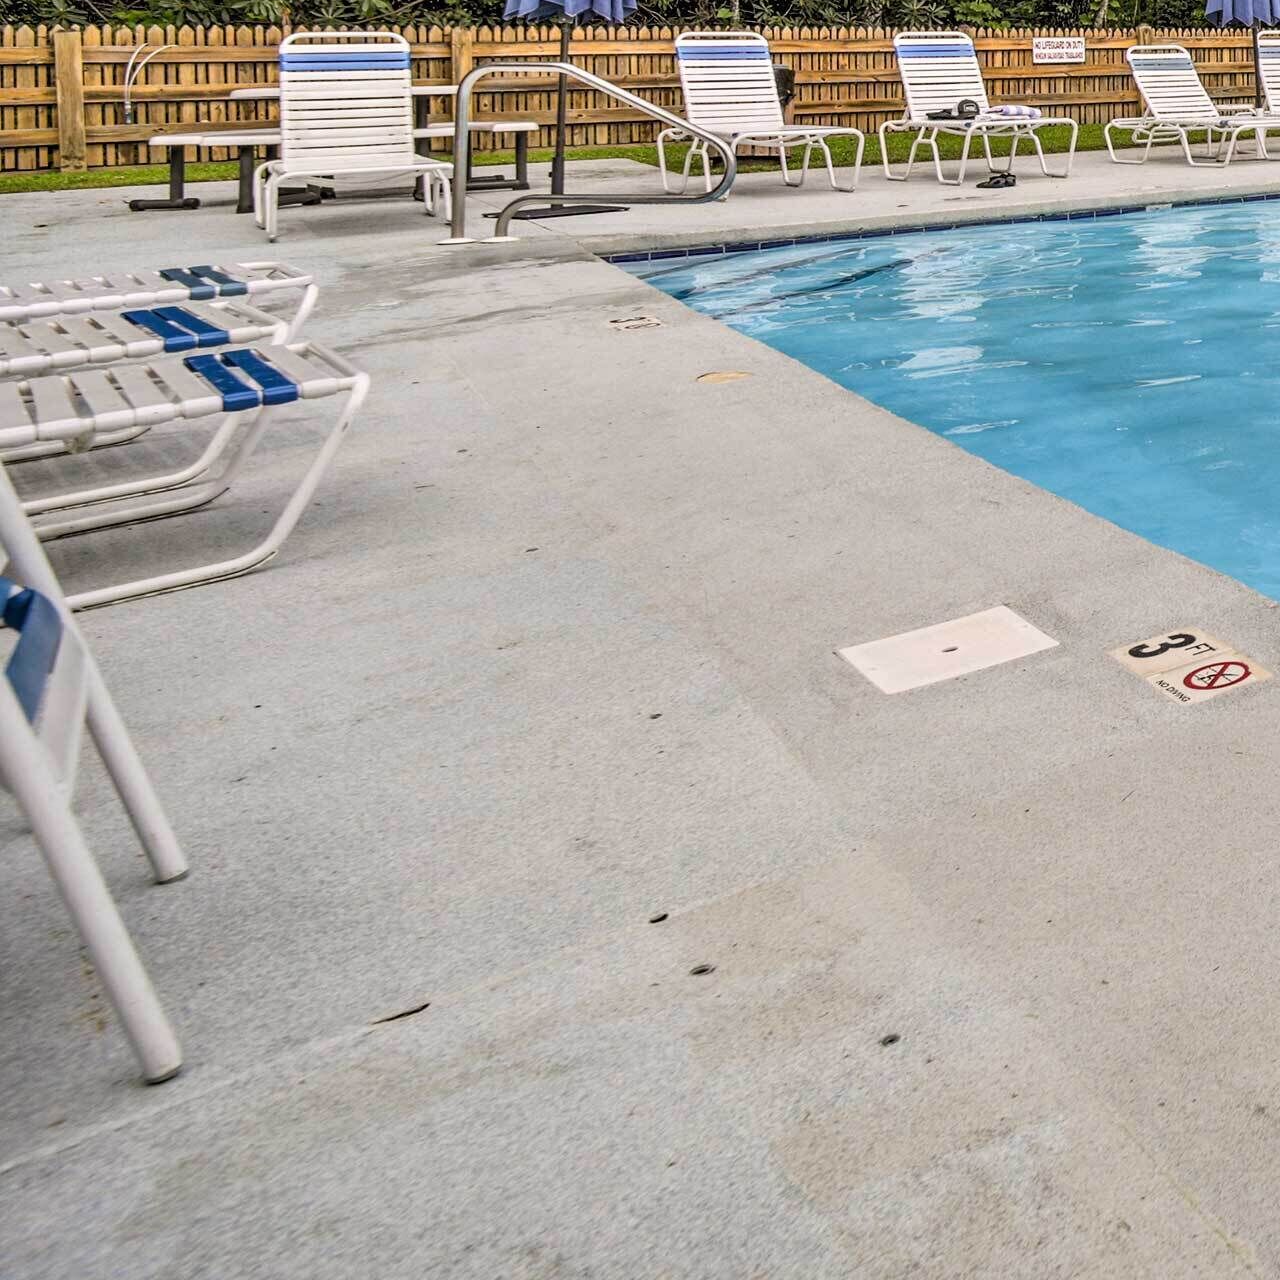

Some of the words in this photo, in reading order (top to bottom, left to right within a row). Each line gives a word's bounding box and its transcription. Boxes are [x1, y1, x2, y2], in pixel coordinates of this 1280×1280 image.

[1035, 41, 1041, 50] NO
[1042, 40, 1065, 50] LIFEGUARD
[1066, 40, 1072, 49] ON
[1072, 40, 1084, 49] DUTY
[1128, 633, 1197, 659] 3
[1185, 642, 1216, 656] FT
[1155, 679, 1169, 689] NO
[1165, 686, 1191, 703] DIVING
